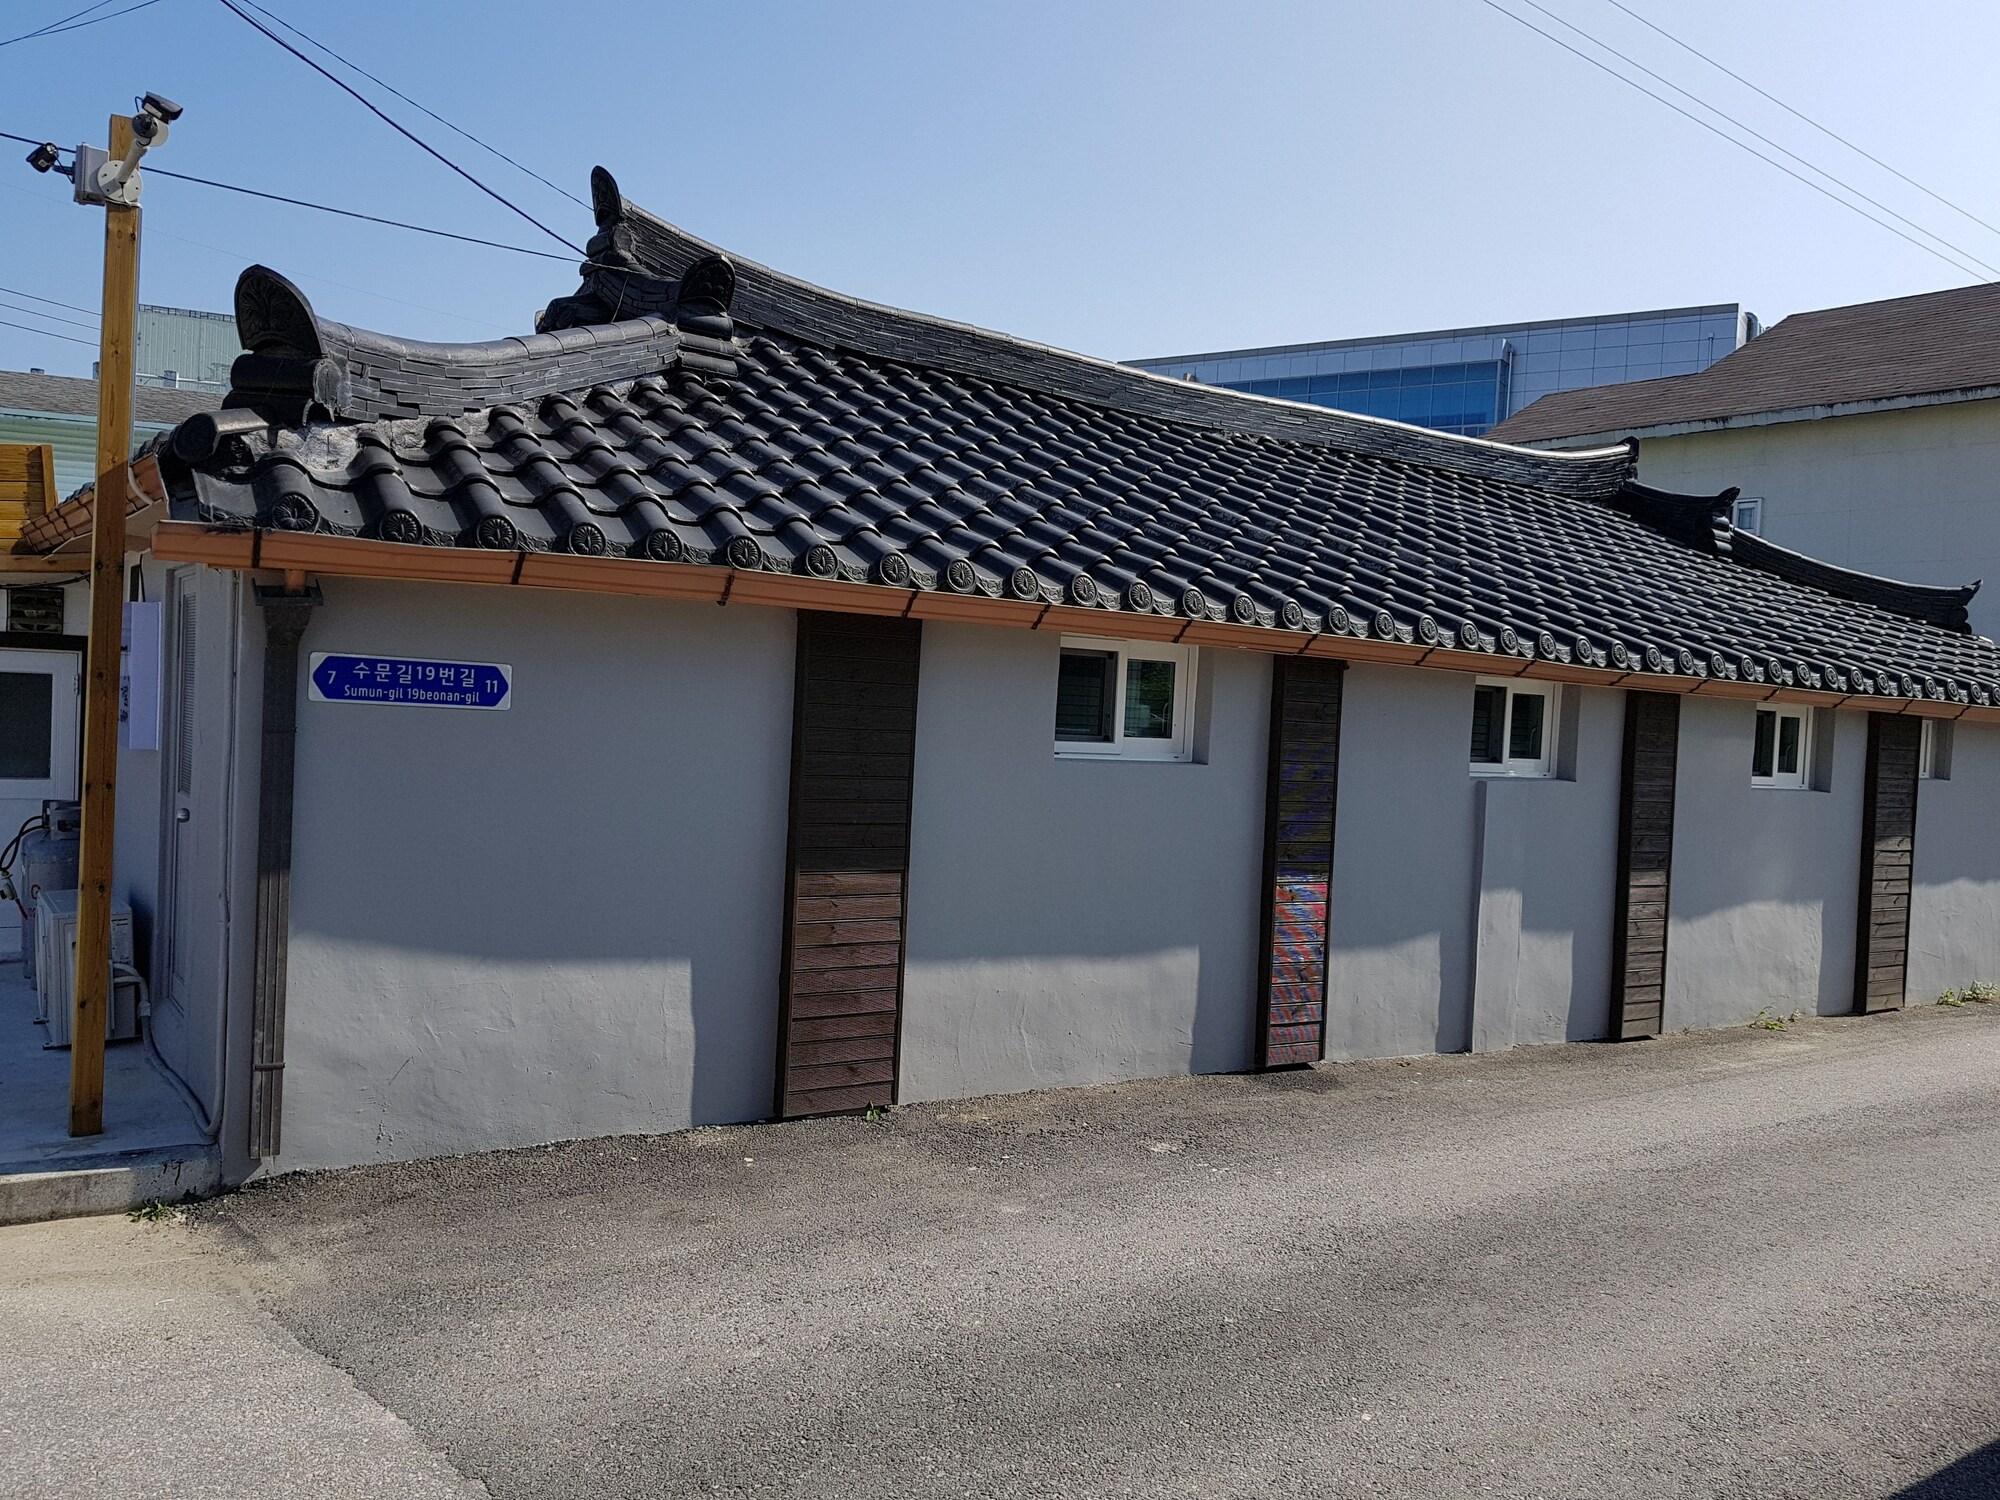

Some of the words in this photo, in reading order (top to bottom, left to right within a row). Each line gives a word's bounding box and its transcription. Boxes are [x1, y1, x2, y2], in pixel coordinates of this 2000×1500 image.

[327, 670, 337, 685] 7
[353, 662, 475, 688] 수문길19번길
[344, 684, 403, 701] Sumun-gil
[407, 687, 480, 705] 19beonan-gil
[485, 679, 498, 694] 11
